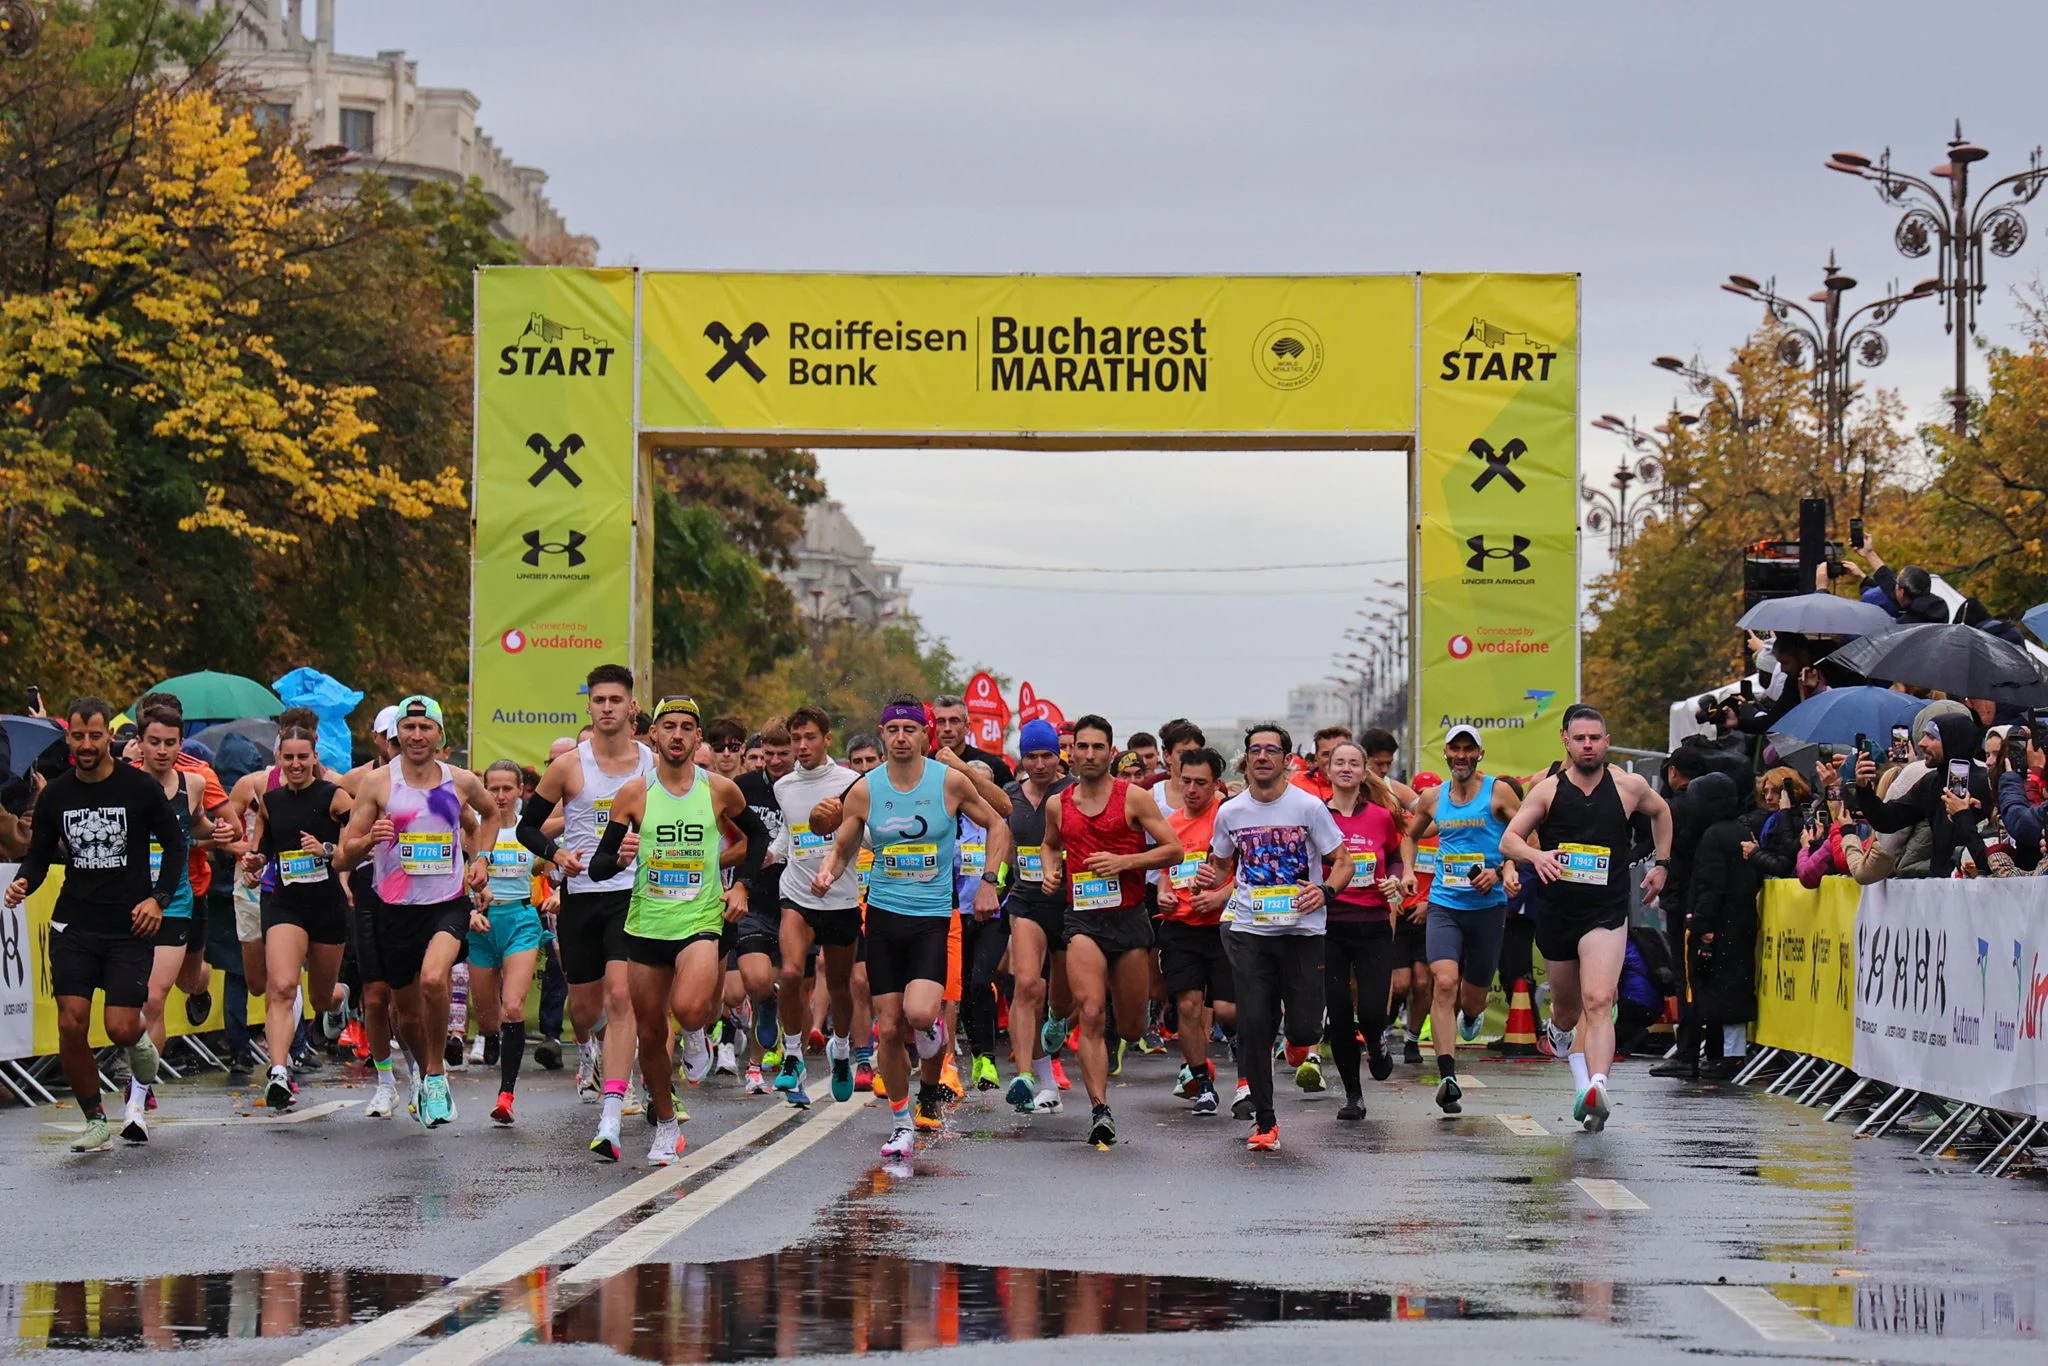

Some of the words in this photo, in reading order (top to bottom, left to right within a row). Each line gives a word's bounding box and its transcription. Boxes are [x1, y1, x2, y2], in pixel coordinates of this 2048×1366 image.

[789, 320, 967, 352] Raiffeisen
[992, 317, 1207, 355] Bucharest
[498, 345, 615, 376] START
[1440, 351, 1557, 381] START
[789, 357, 878, 386] Bank
[992, 357, 1207, 392] MARATHON
[550, 573, 591, 581] ARMOUR
[530, 622, 576, 632] Connected
[577, 624, 588, 634] by
[1477, 626, 1523, 636] Connected
[1525, 627, 1535, 637] by
[530, 635, 603, 649] vodafone
[1477, 640, 1549, 653] vodafone
[492, 709, 577, 724] Autonom
[1440, 715, 1525, 728] Autonom
[1440, 818, 1486, 828] ROMANIA
[72, 855, 128, 869] ZAHARIEV
[1574, 856, 1593, 867] 7942
[663, 873, 685, 883] 8715
[1085, 882, 1104, 893] 5467
